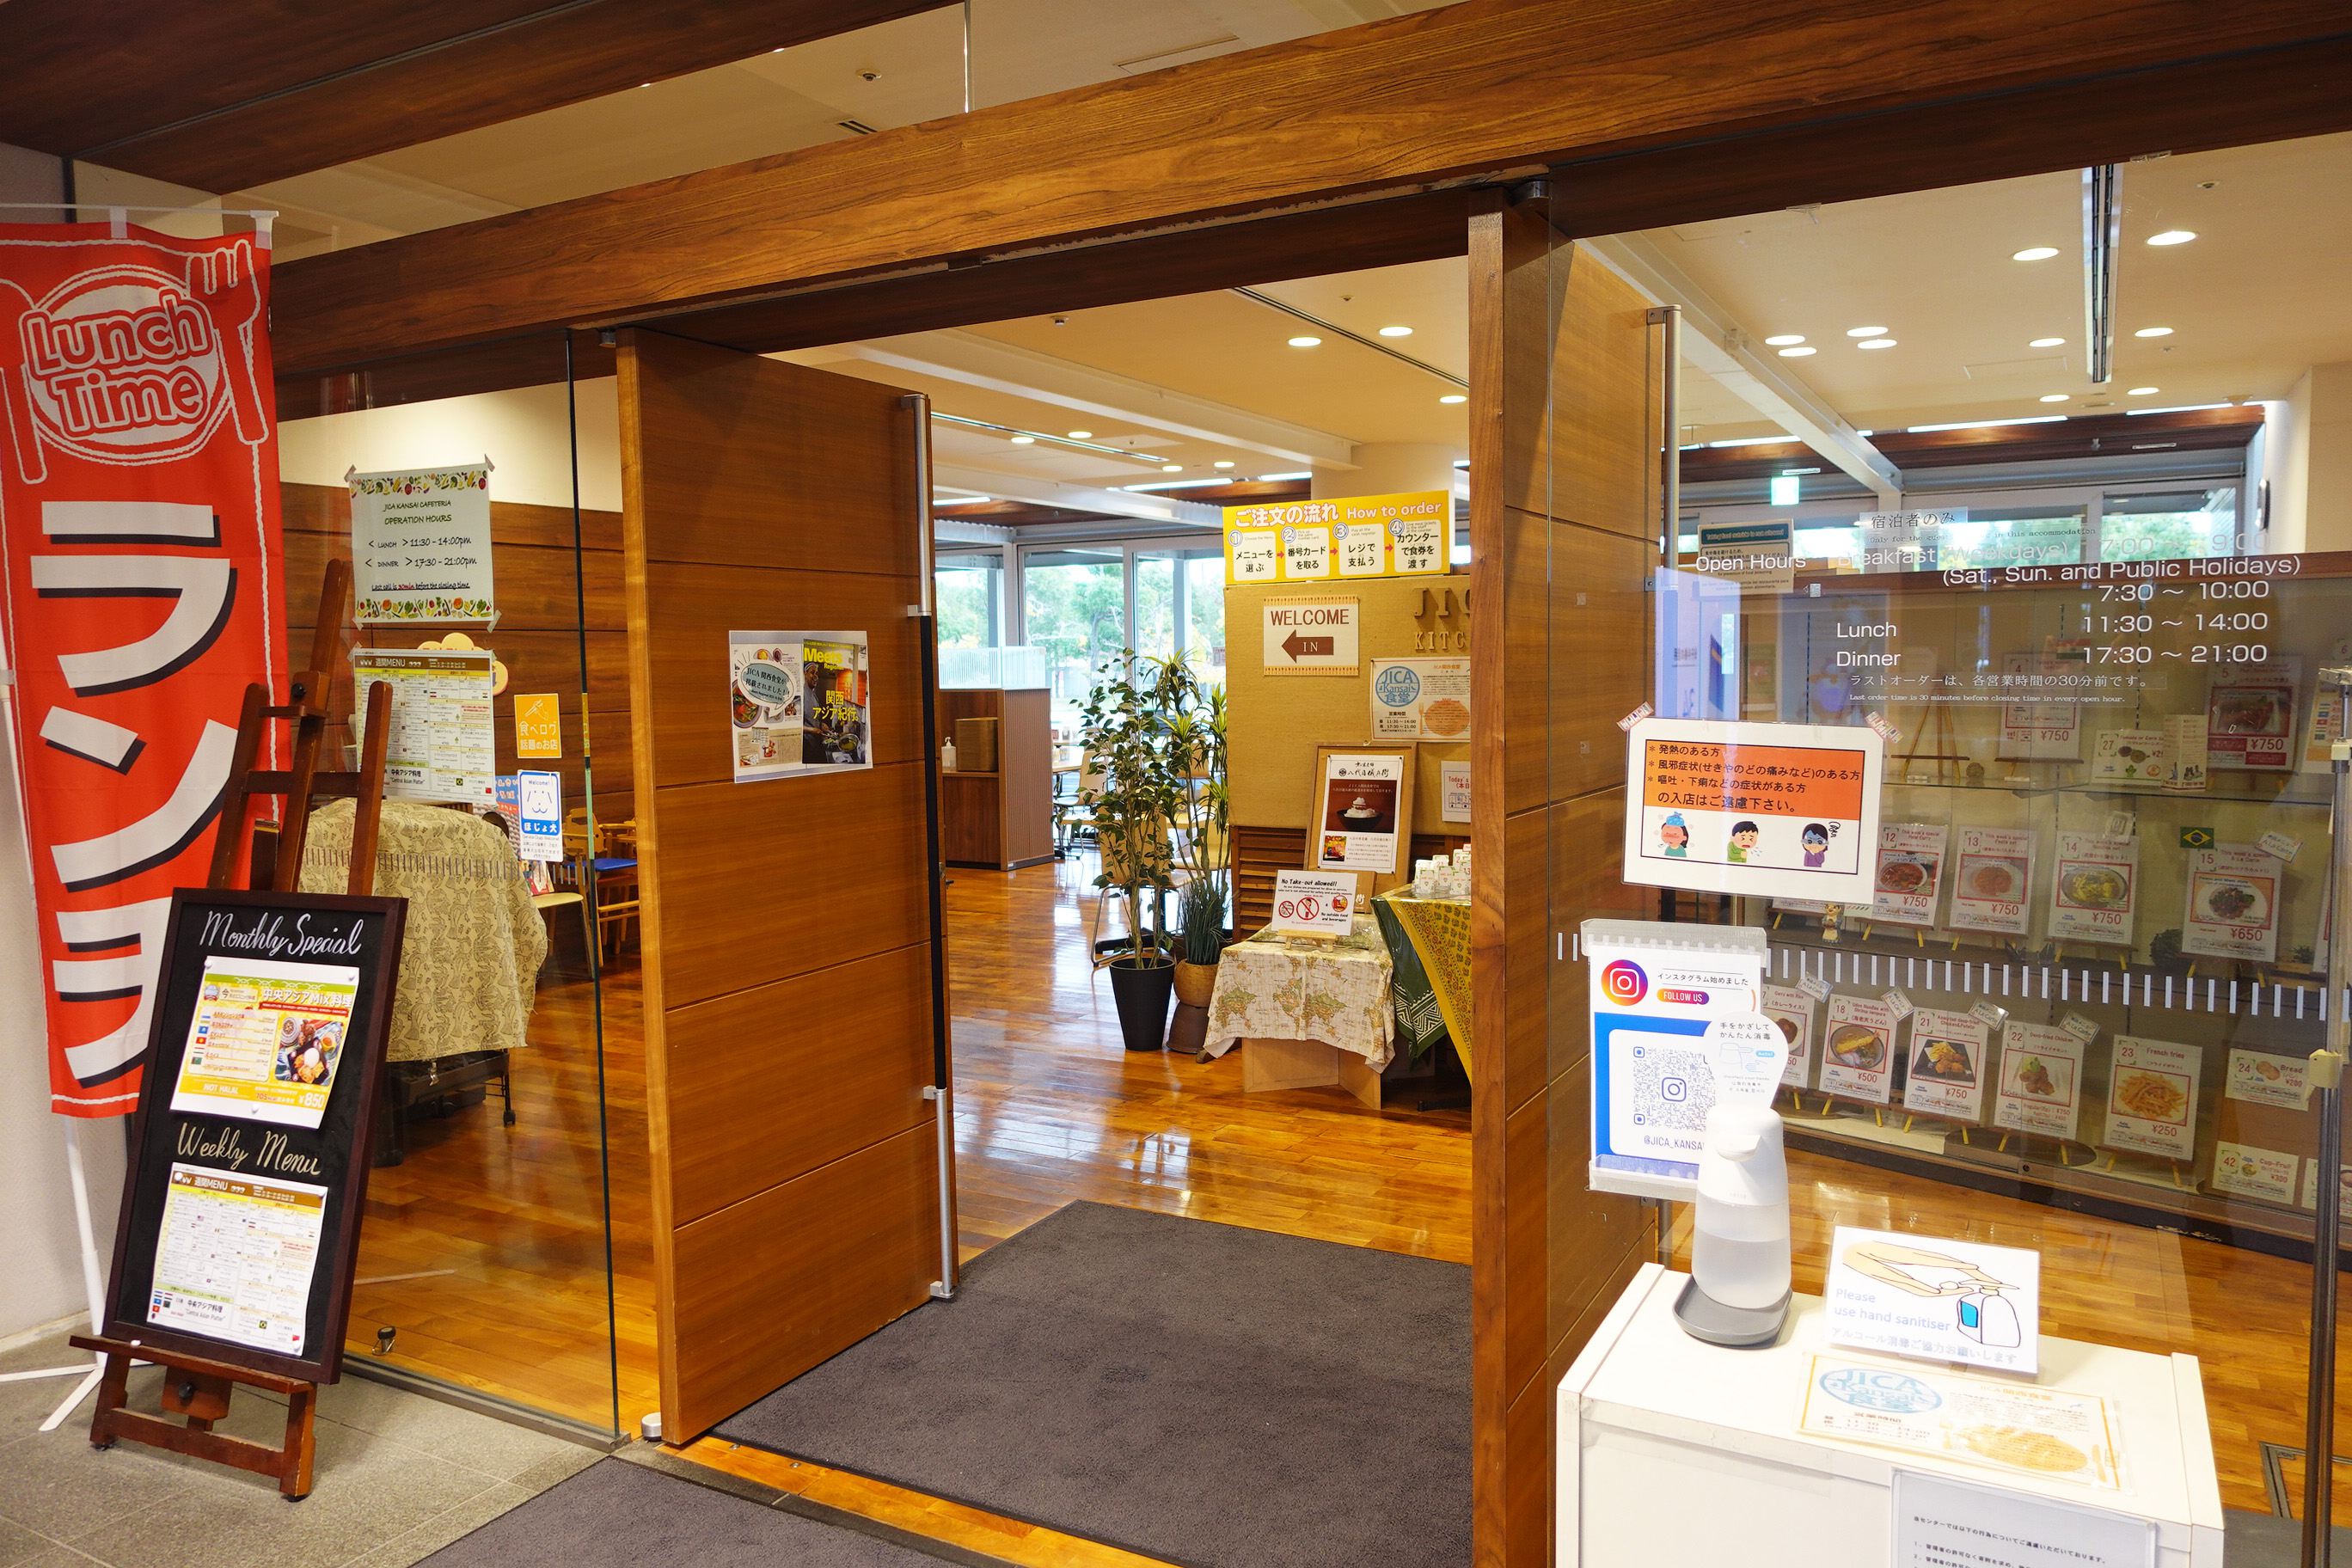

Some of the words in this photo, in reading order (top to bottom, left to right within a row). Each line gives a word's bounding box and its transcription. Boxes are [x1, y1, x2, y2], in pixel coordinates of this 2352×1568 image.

[23, 292, 210, 371] Lunch
[50, 367, 206, 433] Time
[396, 501, 419, 510] KANSAI
[420, 499, 451, 508] CAFETERIA
[384, 516, 424, 525] OPERATION
[426, 514, 452, 524] HOURS
[1234, 502, 1339, 528] ご注文の流れ
[1346, 506, 1377, 520] How
[1381, 505, 1397, 517] to
[1400, 501, 1442, 515] order
[1871, 511, 1956, 530] 宿泊者のみ
[1397, 532, 1439, 543] カウンター
[1870, 535, 1888, 543] Only
[2006, 530, 2025, 538] this
[2029, 527, 2096, 537] accommodation
[410, 537, 431, 547] 11:30
[1348, 542, 1375, 554] レジで
[1235, 549, 1274, 560] メニューを
[1288, 546, 1326, 557] 番号カード
[1401, 545, 1435, 556] で食券を
[1838, 548, 1936, 567] Breakfast
[1943, 541, 2068, 565] (Weekdays)
[2098, 537, 2154, 556] 7:00
[2211, 531, 2269, 552] 9:00
[414, 558, 437, 569] 17:30
[1295, 560, 1320, 570] を取る
[1348, 556, 1375, 567] 支払う
[1407, 559, 1428, 569] 渡す
[1695, 556, 1743, 573] Open
[1750, 554, 1806, 569] Hours
[1246, 563, 1265, 573] 選ぶ
[1942, 567, 1998, 587] (Sat.,
[2005, 566, 2053, 583] Sun.
[2061, 562, 2102, 581] and
[2110, 560, 2181, 579] Public
[2189, 555, 2301, 578] Holidays)
[2098, 584, 2154, 602] 7:30
[2199, 580, 2270, 600] 10:00
[1270, 609, 1350, 626] WELCOME
[1836, 622, 1897, 638] Lunch
[2084, 615, 2153, 634] 11:30
[2195, 613, 2269, 631] 14:00
[1302, 641, 1320, 652] IN
[803, 647, 843, 665] Meets
[1836, 651, 1902, 667] Dinner
[2083, 646, 2153, 664] 17:30
[2190, 645, 2269, 664] 21:00
[1381, 670, 1413, 684] JICA
[1850, 674, 2147, 688] ラストオーダーは、各営業時間の30分前です。
[1382, 683, 1412, 693] Kansai
[825, 689, 844, 706] 関西
[1385, 692, 1411, 703] 食堂
[812, 706, 859, 721] アジア紀行。
[519, 720, 557, 737] 食べログ
[2041, 730, 2069, 742] ¥750
[520, 738, 558, 750] 話題のお店
[2103, 740, 2114, 750] 27
[2251, 738, 2284, 750] ¥750
[1659, 744, 1720, 757] 発熱のある方
[1657, 759, 1861, 781] 風邪症状(せきやのどの痛みなど)のある方
[1657, 775, 1807, 793] 嘔吐・下痢などの症状がある方
[1657, 792, 1795, 812] の入店はご遠慮下さい。
[524, 822, 558, 834] ほじょ犬
[1885, 832, 1896, 842] 12
[1968, 836, 1979, 847] 13
[2065, 842, 2077, 853] 14
[2201, 853, 2214, 864] 15
[1903, 896, 1928, 908] ¥750
[1992, 903, 2019, 916] ¥750
[2092, 912, 2122, 925] ¥750
[199, 910, 290, 956] Monthly
[287, 913, 364, 956] Special
[2230, 928, 2263, 941] ¥650
[1657, 972, 1749, 986] インスタグラム始めました
[262, 988, 352, 1008] 中央アジアMix料理
[1663, 990, 1692, 1001] FOLLOW
[1693, 993, 1703, 1002] US
[1835, 1005, 1846, 1014] 18
[1720, 1021, 1770, 1031] 手をかざして
[1920, 1017, 1930, 1027] 21
[1719, 1032, 1771, 1040] かんたん消毒
[2011, 1032, 2023, 1042] 22
[2121, 1047, 2135, 1057] 23
[2146, 1048, 2168, 1057] French
[2238, 1063, 2251, 1074] 24
[2280, 1064, 2303, 1074] Bread
[1858, 1072, 1877, 1083] ¥500
[1945, 1087, 1968, 1099] ¥750
[2152, 1124, 2177, 1137] ¥250
[176, 1122, 248, 1170] Weekly
[256, 1130, 322, 1176] Menu
[2223, 1156, 2236, 1167] 42
[1835, 1288, 1877, 1303] Please
[1834, 1307, 1856, 1317] use
[1859, 1308, 1891, 1323] hand
[1896, 1315, 1951, 1332] sanitiser
